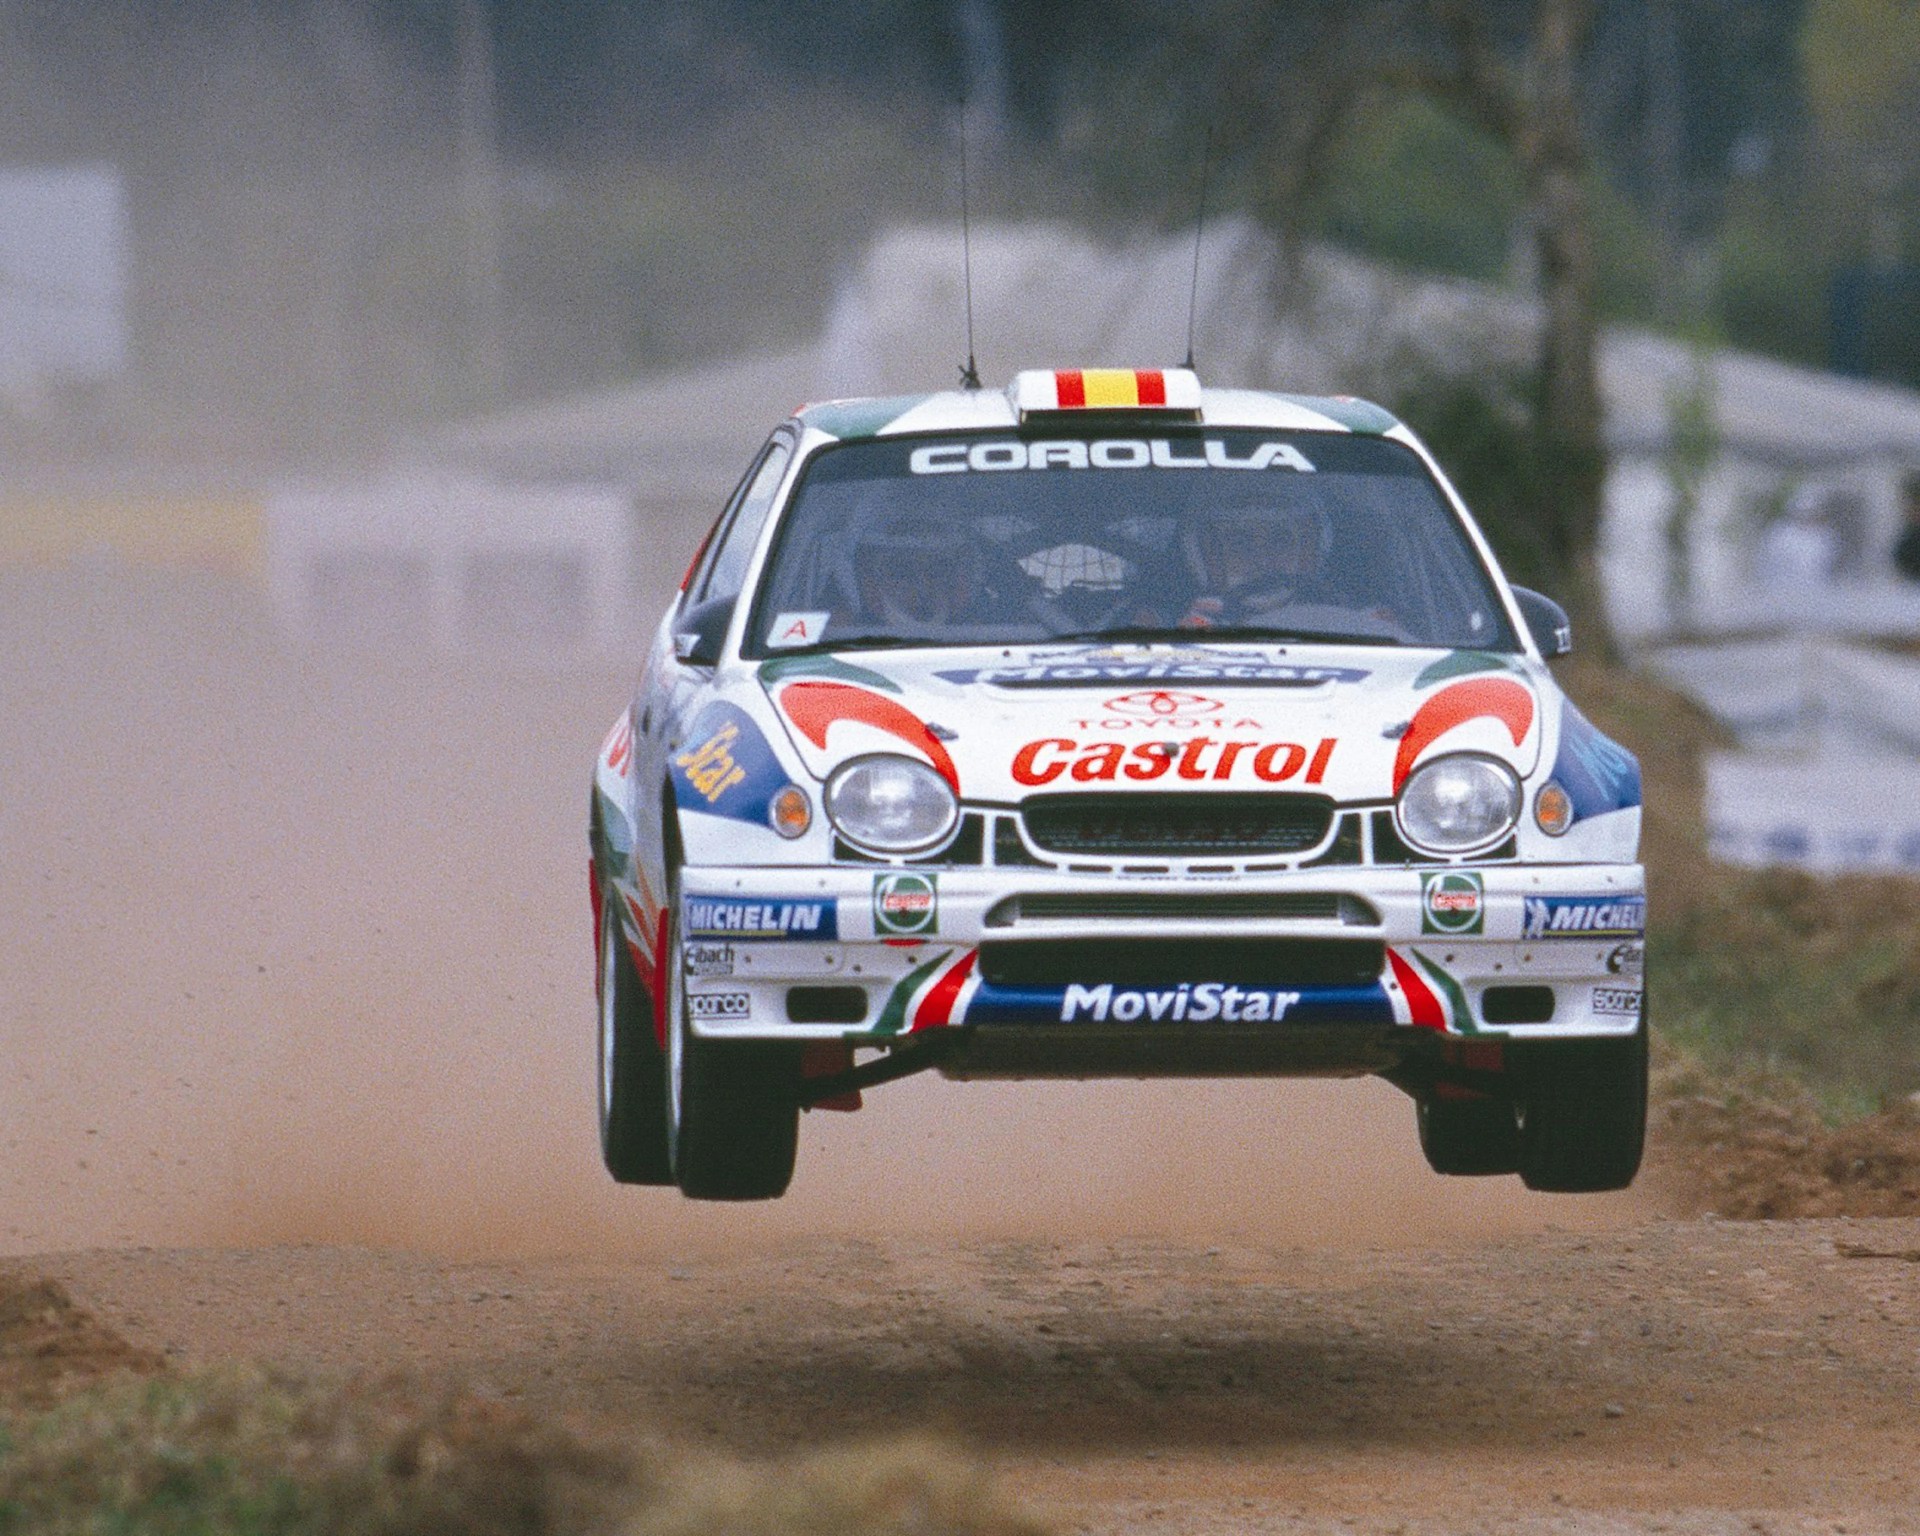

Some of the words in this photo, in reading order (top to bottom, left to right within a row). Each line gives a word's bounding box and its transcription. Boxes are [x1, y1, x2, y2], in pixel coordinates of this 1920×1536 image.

[909, 440, 1317, 474] COROLLA
[782, 619, 807, 639] A
[1073, 717, 1263, 730] TOYOTA
[1010, 735, 1339, 787] Castrol
[689, 904, 822, 930] MICHELIN
[1060, 983, 1300, 1022] MoviStar
